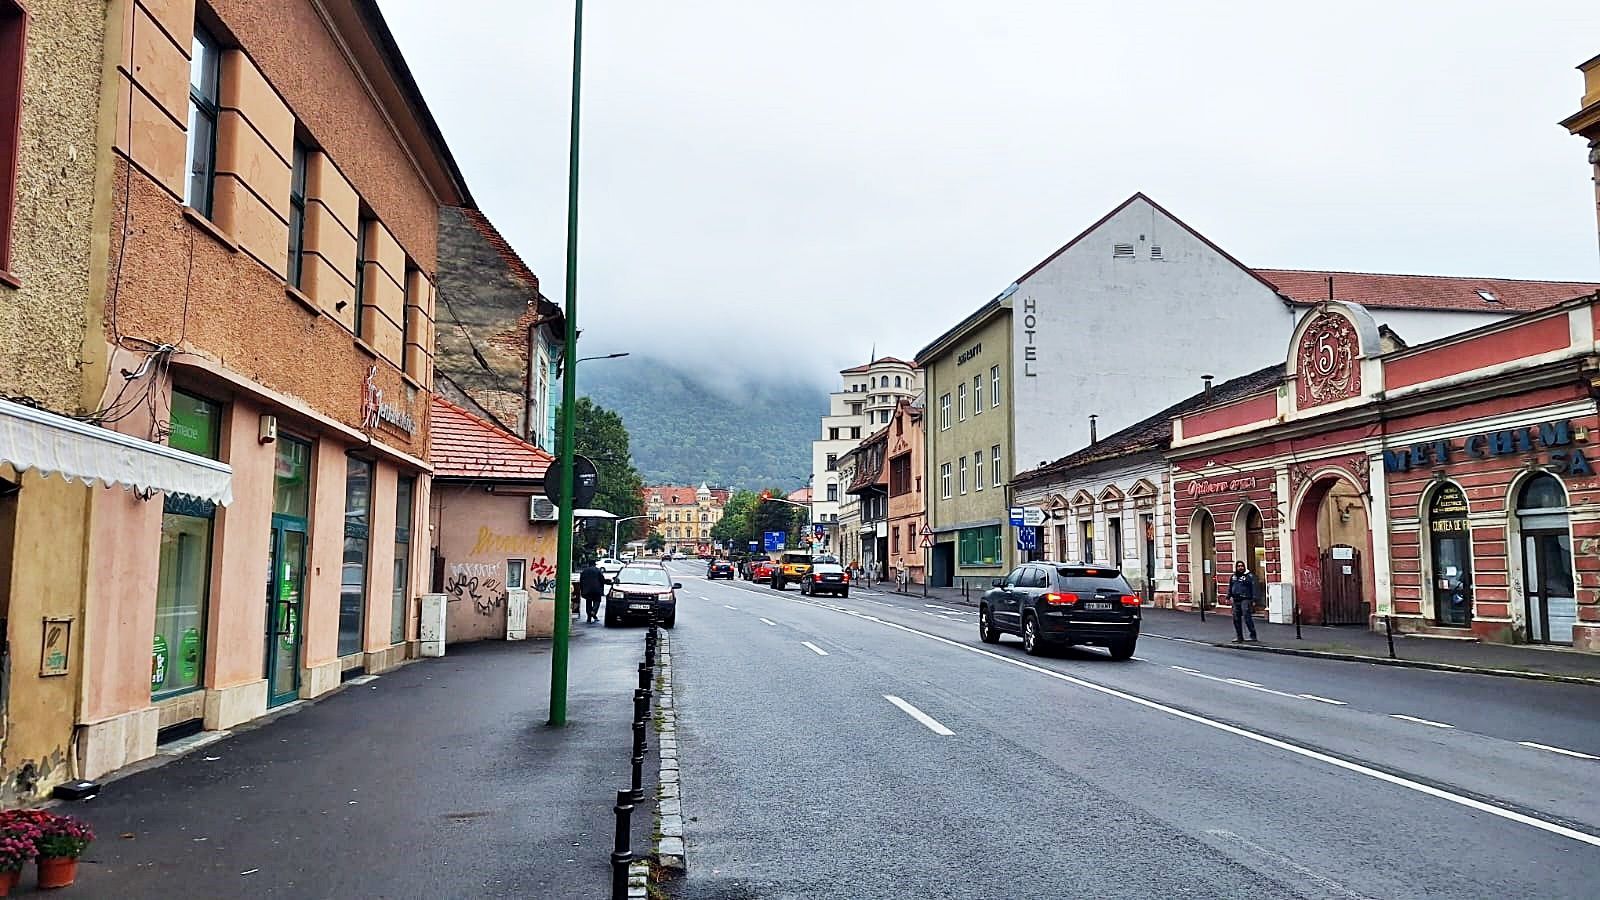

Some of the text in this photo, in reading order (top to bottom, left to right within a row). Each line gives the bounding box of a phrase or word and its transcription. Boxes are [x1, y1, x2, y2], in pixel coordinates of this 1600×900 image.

[1024, 299, 1037, 377] HOTEL
[1319, 332, 1334, 373] 5
[1383, 419, 1572, 472] MET CHIM
[1551, 448, 1593, 476] SA
[1432, 520, 1454, 532] CURTEA
